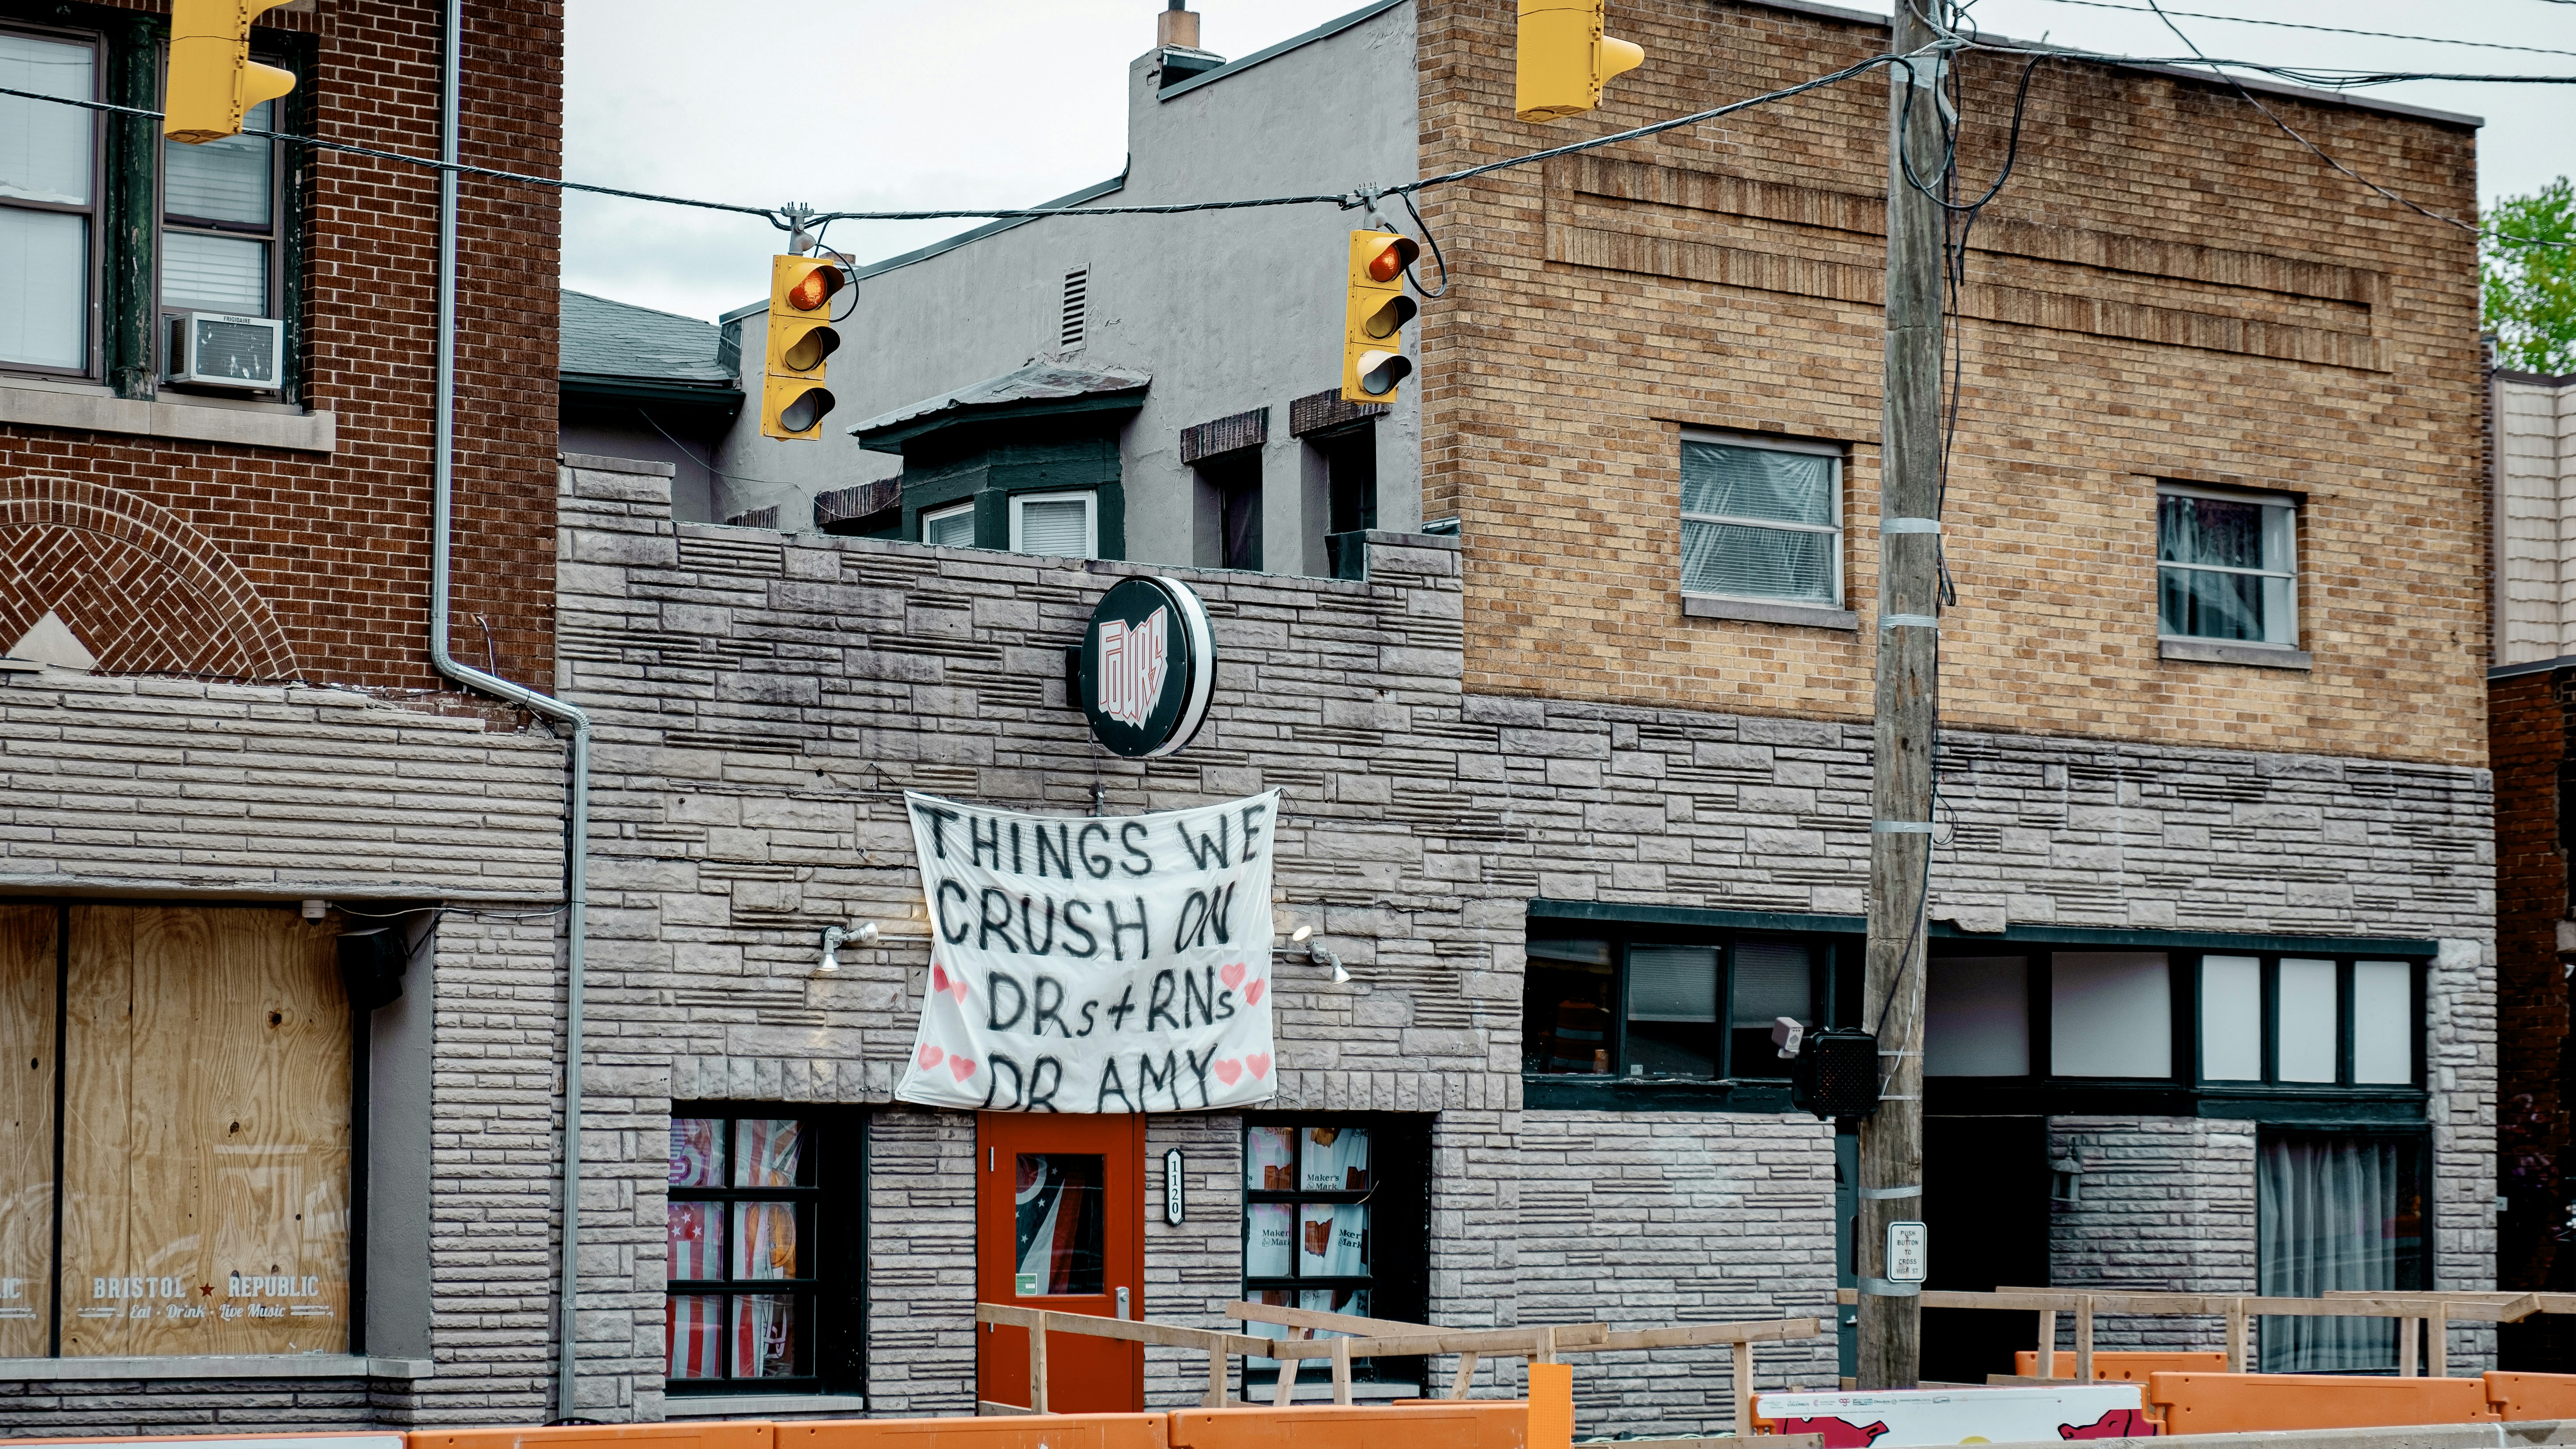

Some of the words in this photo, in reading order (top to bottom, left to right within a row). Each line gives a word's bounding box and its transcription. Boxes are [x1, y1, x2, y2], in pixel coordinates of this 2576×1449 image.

[223, 316, 251, 324] FRIGIDAIRE
[912, 802, 1151, 879] THINGS
[1178, 805, 1265, 871] WE
[938, 879, 1150, 961] CRUSH
[1175, 881, 1235, 954] ON
[984, 1053, 1062, 1113] DR
[1097, 1044, 1218, 1113] AMY
[93, 1277, 186, 1298] BRISTOL
[228, 1276, 319, 1297] REPUBLIC
[130, 1304, 151, 1319] Eat
[167, 1304, 205, 1318] Drink
[219, 1304, 244, 1321] Live
[248, 1303, 286, 1318] Music
